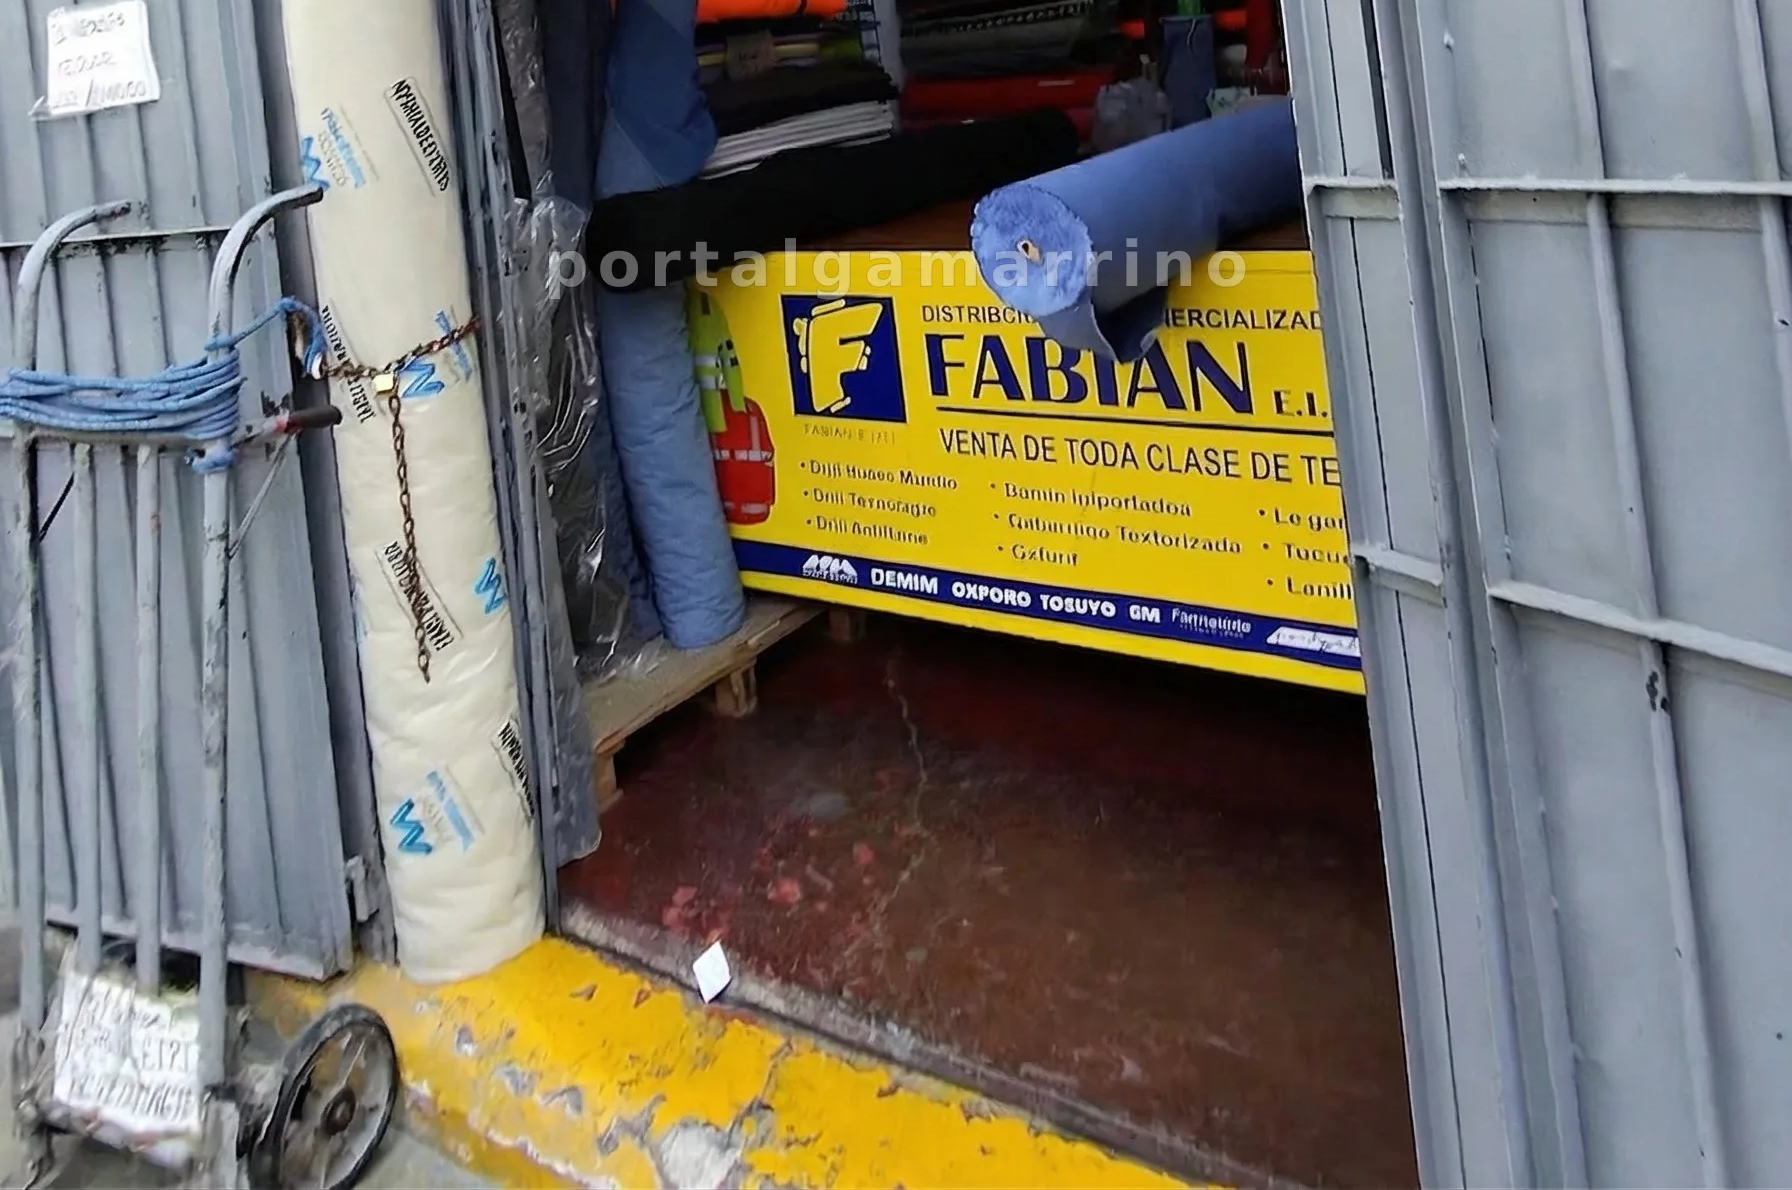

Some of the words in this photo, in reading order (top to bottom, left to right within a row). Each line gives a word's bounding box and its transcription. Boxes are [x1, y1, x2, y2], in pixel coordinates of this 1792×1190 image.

[924, 333, 1254, 415] FABIAN
[939, 428, 1018, 460] VENTA
[1025, 435, 1058, 463] DE
[1064, 438, 1139, 470] TODA
[1147, 444, 1240, 478] CLASE
[1251, 451, 1293, 484] DE
